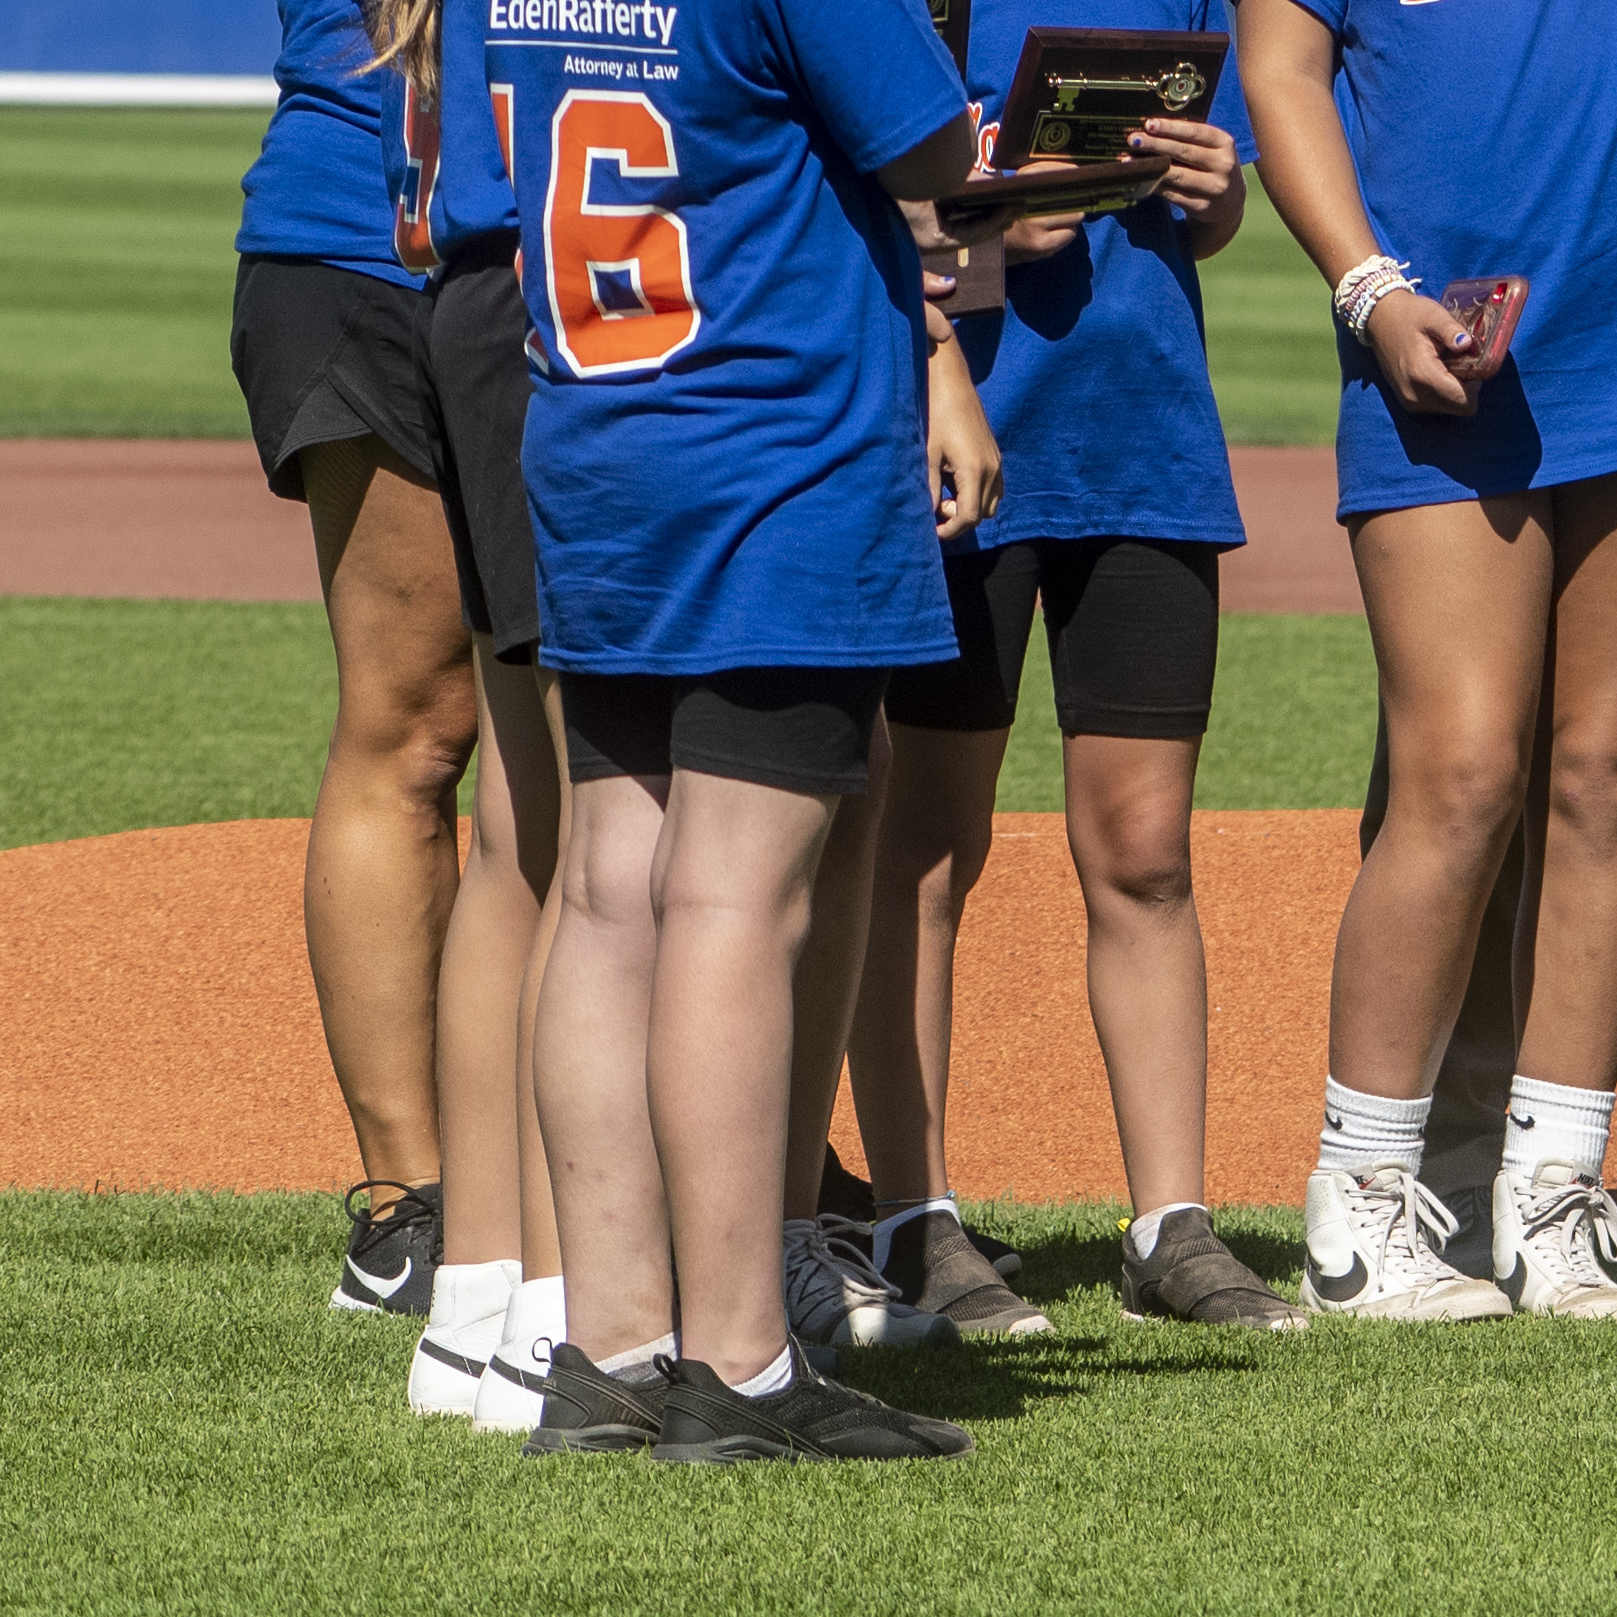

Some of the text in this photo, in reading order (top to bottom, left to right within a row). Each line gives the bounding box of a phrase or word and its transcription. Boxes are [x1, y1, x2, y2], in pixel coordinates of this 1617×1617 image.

[564, 54, 679, 80] Attorney at Law
[544, 87, 700, 380] 6
